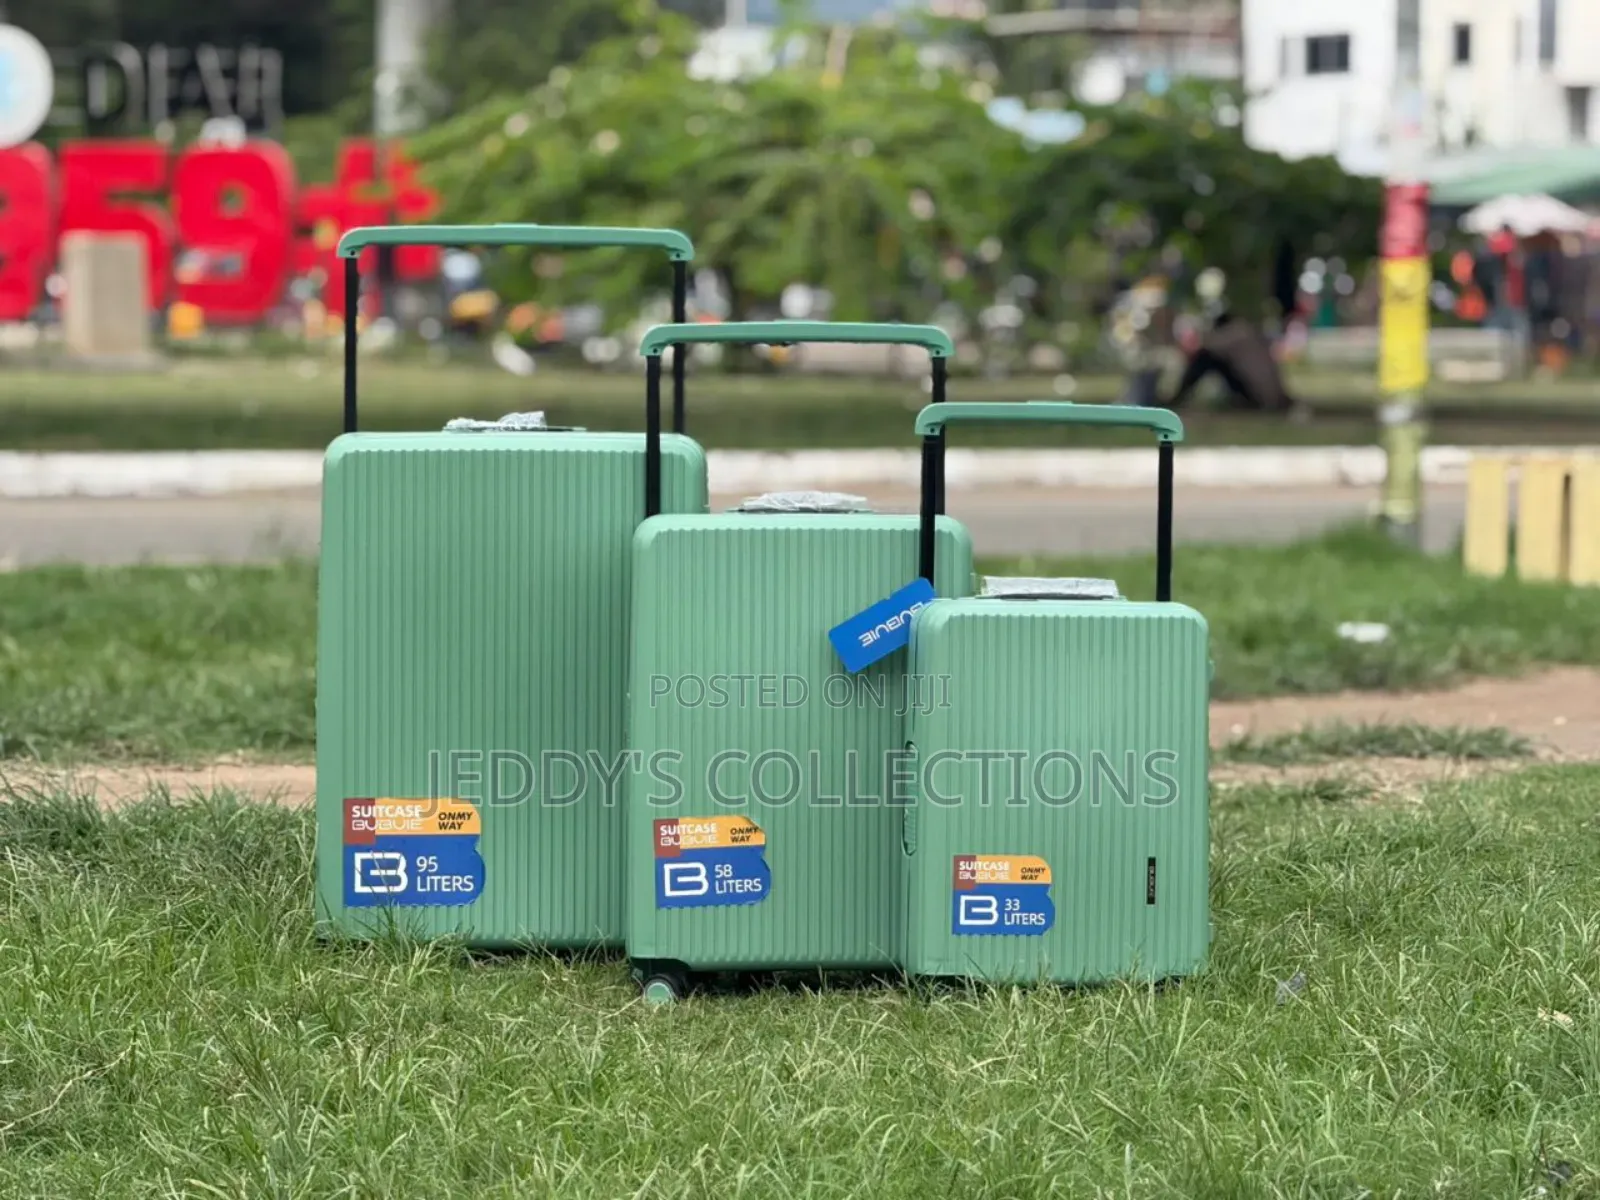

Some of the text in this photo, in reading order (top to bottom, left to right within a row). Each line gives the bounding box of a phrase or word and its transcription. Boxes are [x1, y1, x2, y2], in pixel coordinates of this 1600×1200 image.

[352, 805, 423, 818] SUITCASE
[438, 811, 474, 821] ONMY
[352, 819, 424, 831] BUBUIE
[438, 822, 464, 831] WAY
[660, 823, 717, 836] SUITCASE
[730, 826, 759, 835] ONMY
[730, 835, 752, 843] WAY
[416, 856, 438, 873] 95
[714, 864, 733, 878] 58
[959, 861, 1010, 871] SUITCASE
[1020, 866, 1047, 874] ONMY
[416, 875, 475, 892] LITERS
[715, 878, 763, 894] LITERS
[1004, 898, 1021, 911] 33
[1004, 913, 1046, 926] LITERS
